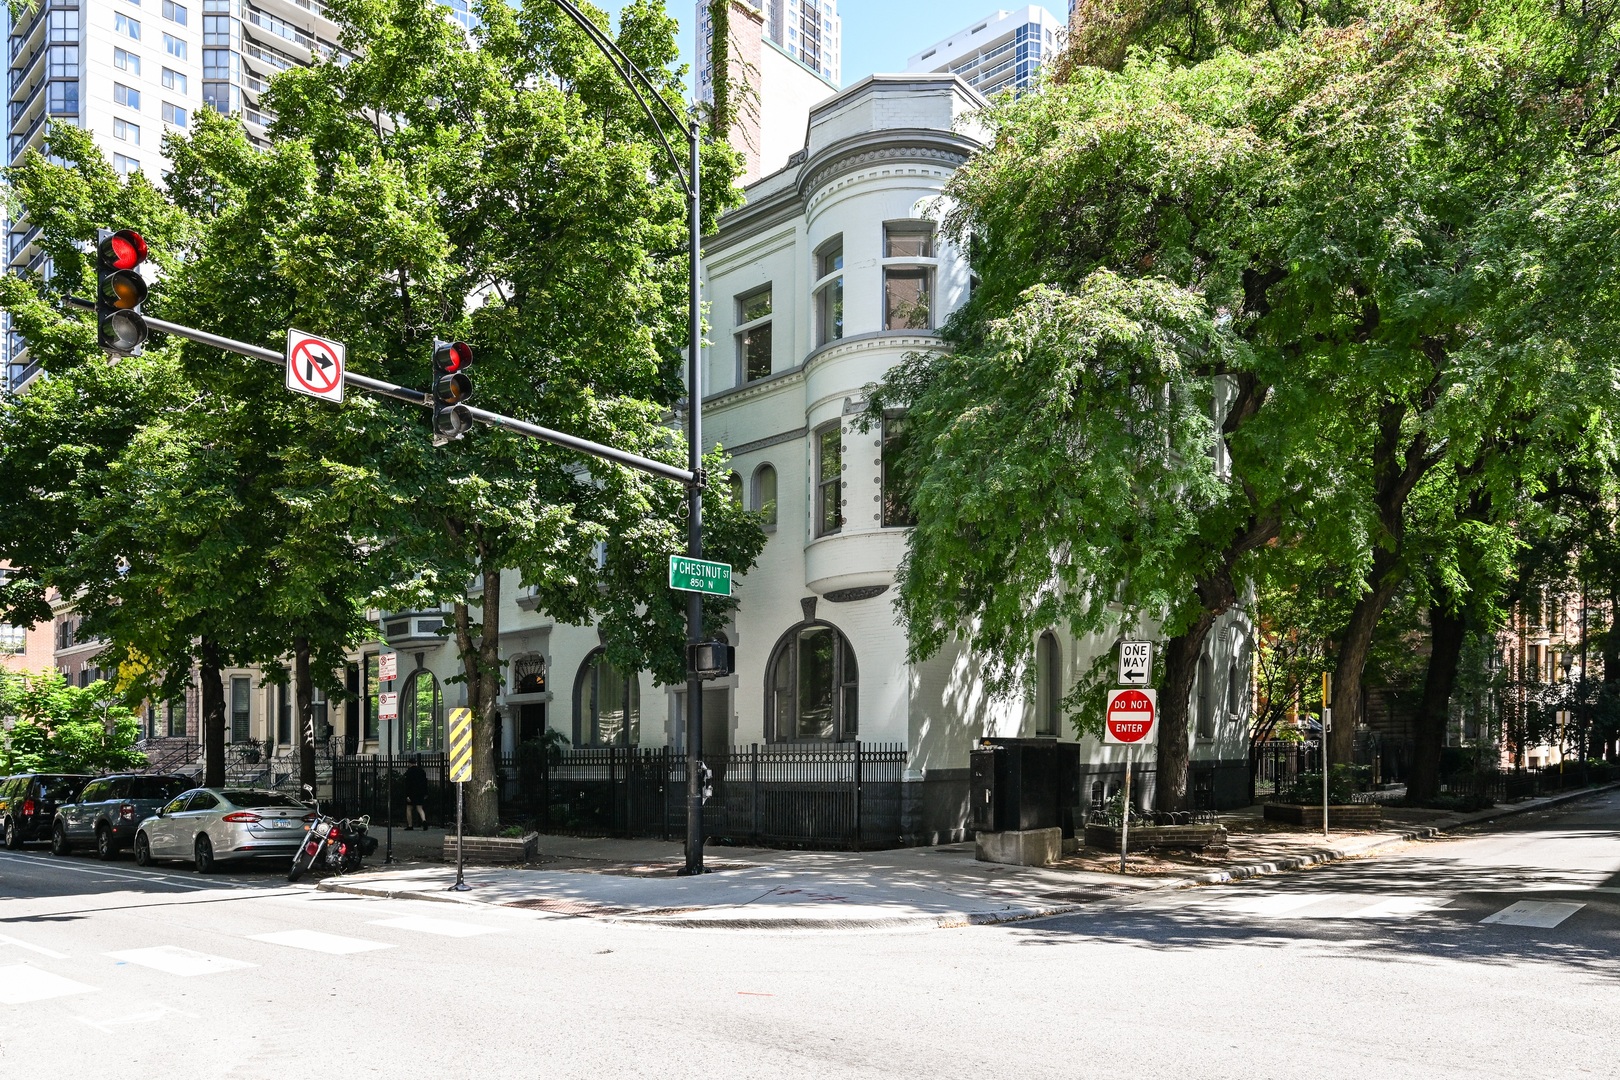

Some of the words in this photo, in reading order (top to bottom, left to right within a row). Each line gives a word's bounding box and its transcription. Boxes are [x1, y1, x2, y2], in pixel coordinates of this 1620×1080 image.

[679, 561, 721, 579] CHESTNUT
[722, 570, 729, 579] ST
[690, 577, 704, 588] 850
[708, 580, 714, 589] N
[1124, 645, 1147, 656] ONE
[1123, 657, 1147, 668] WAY
[1114, 700, 1126, 709] DO
[1130, 700, 1148, 709] NOT
[1115, 723, 1143, 733] ENTER
